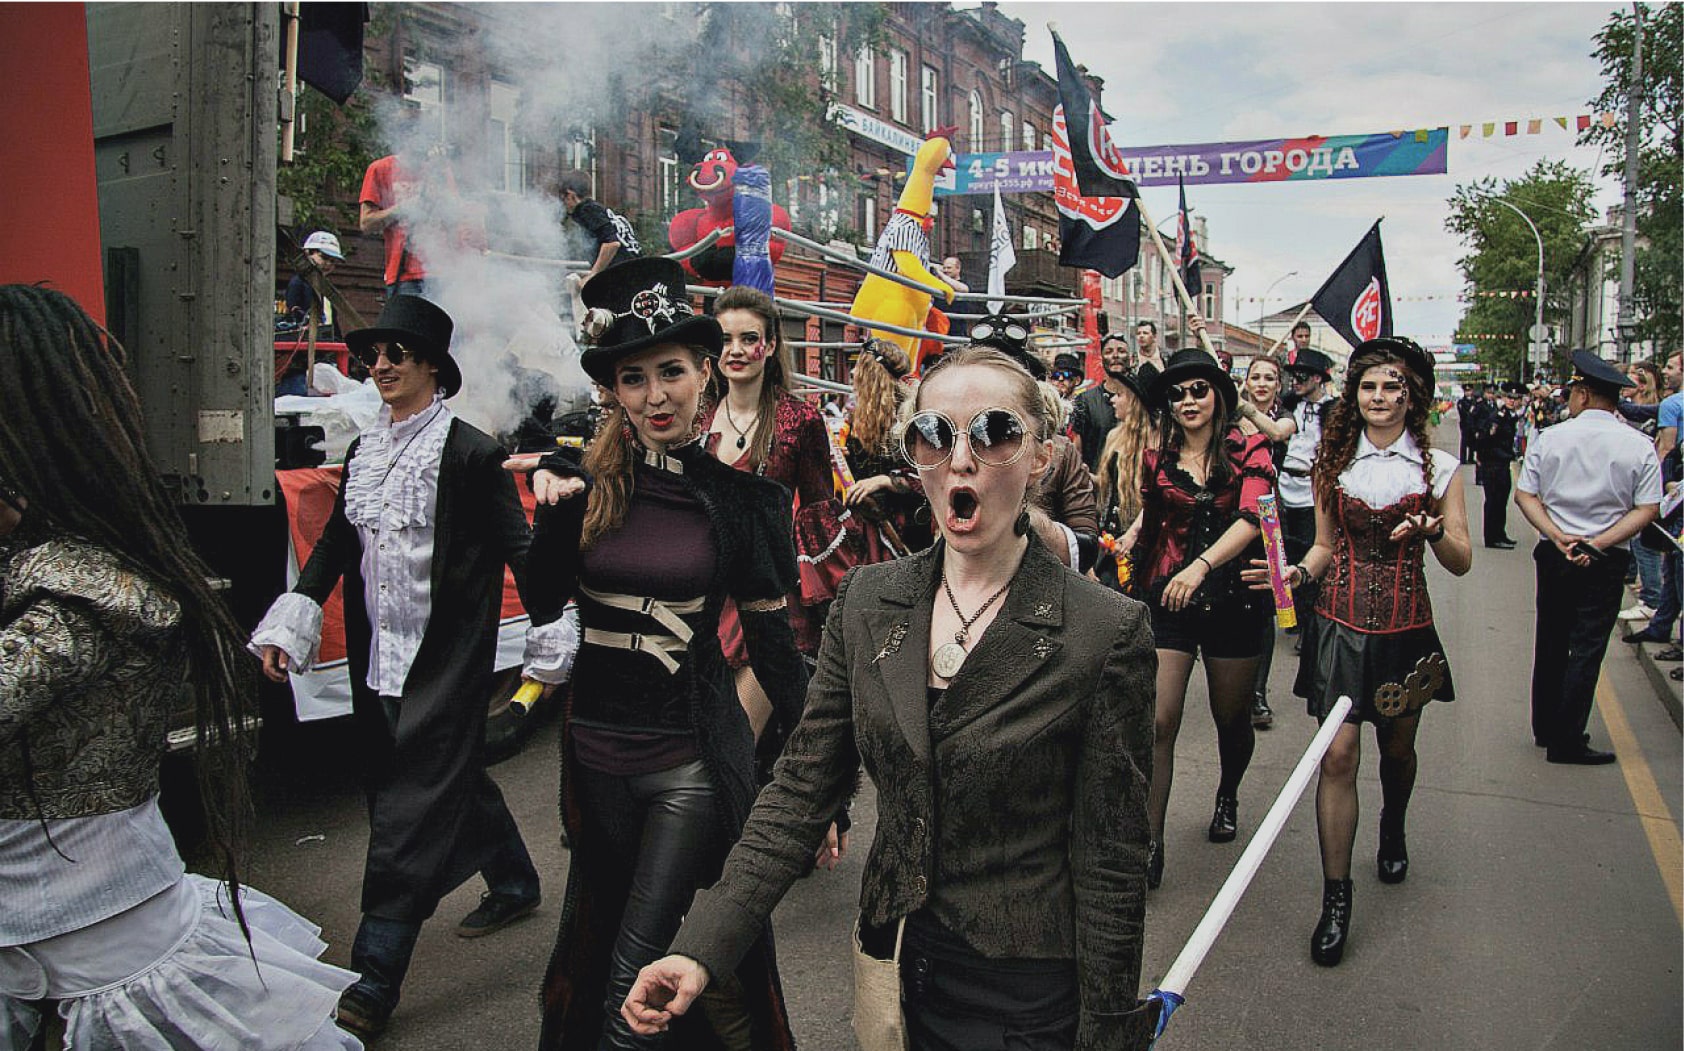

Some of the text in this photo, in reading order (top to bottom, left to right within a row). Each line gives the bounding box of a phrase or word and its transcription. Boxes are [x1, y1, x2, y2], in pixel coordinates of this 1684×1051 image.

[968, 158, 1010, 178] 4-5
[1122, 153, 1210, 184] ДЕНЬ
[1220, 146, 1360, 177] ГОРОДА
